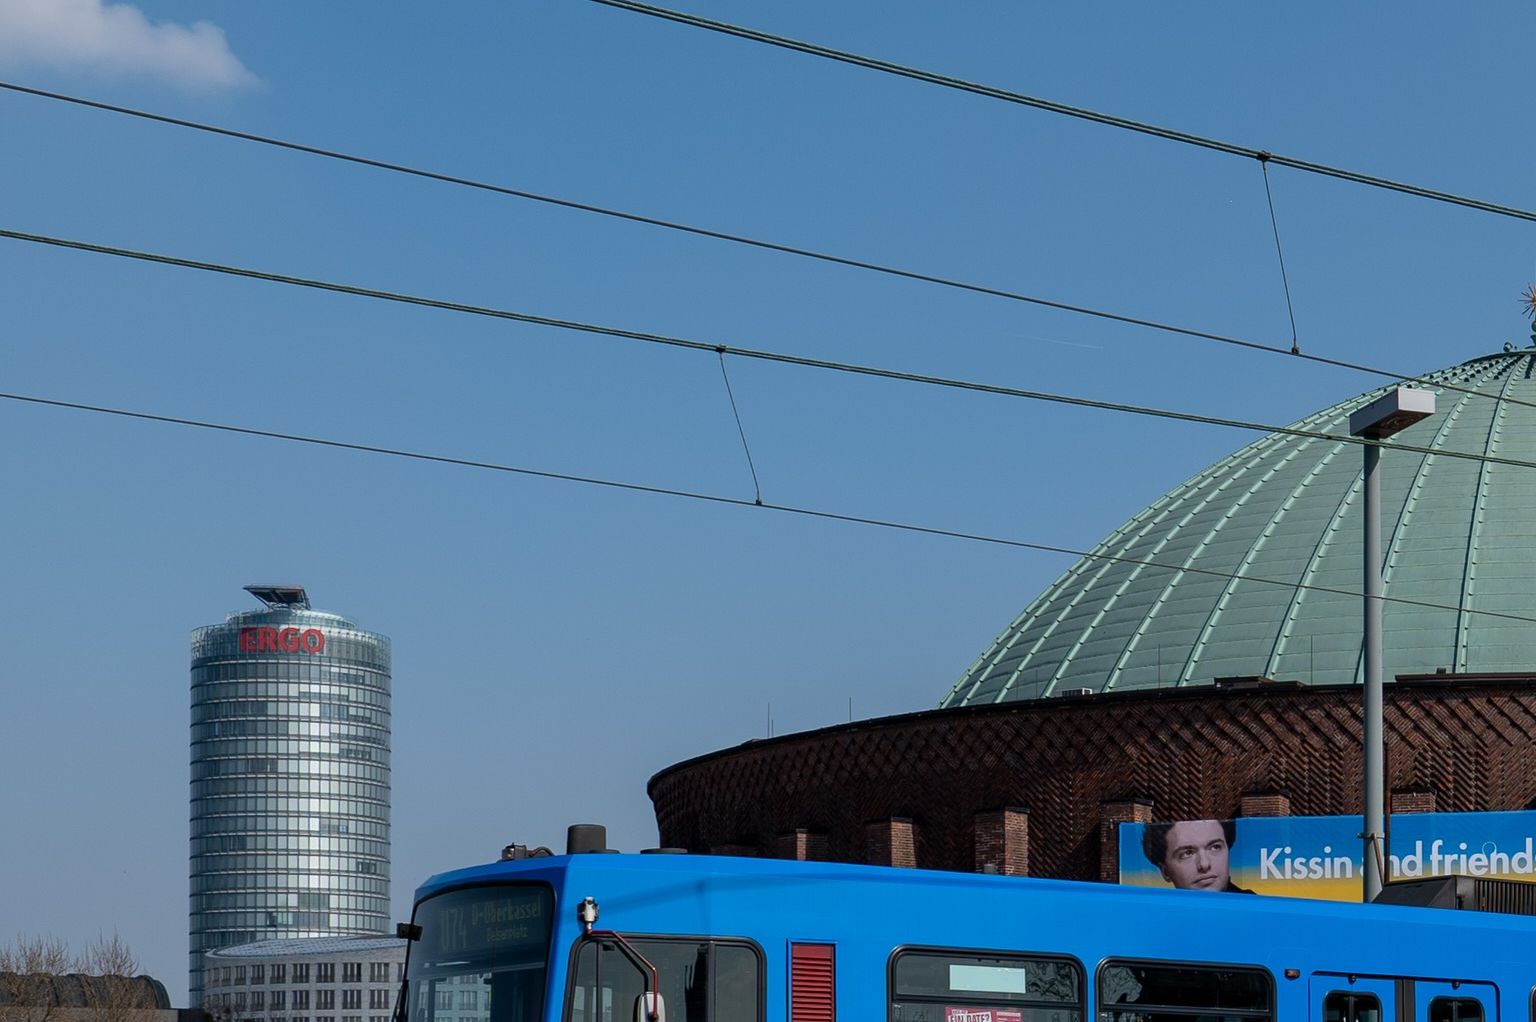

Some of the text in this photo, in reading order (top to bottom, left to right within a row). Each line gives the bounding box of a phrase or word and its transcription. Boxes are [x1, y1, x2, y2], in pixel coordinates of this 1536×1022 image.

[241, 624, 326, 654] ERGO
[1260, 846, 1352, 879] Kissin
[1360, 840, 1423, 877] nd
